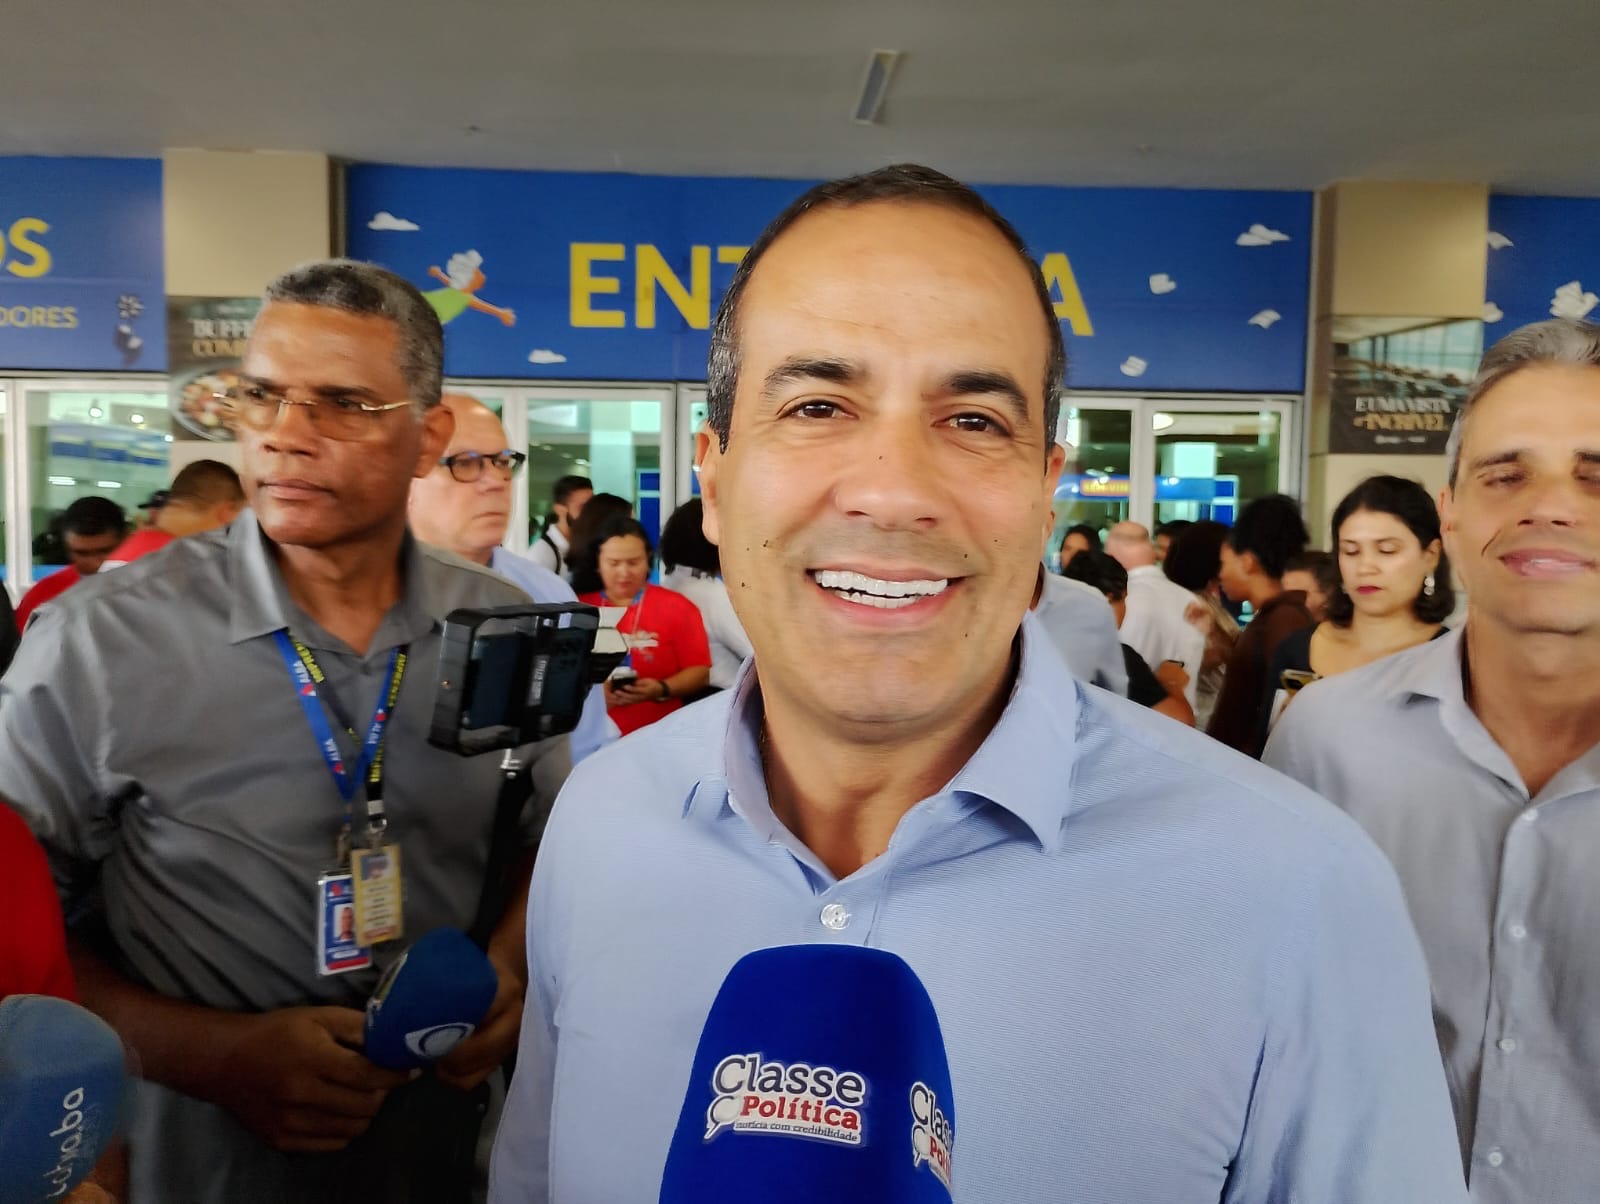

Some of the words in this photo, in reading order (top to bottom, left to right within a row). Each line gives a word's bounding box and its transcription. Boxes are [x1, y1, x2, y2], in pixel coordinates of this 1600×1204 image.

[715, 1057, 863, 1103] Classe
[740, 1095, 858, 1130] Política
[770, 1121, 791, 1132] com
[793, 1126, 858, 1142] credibilidade
